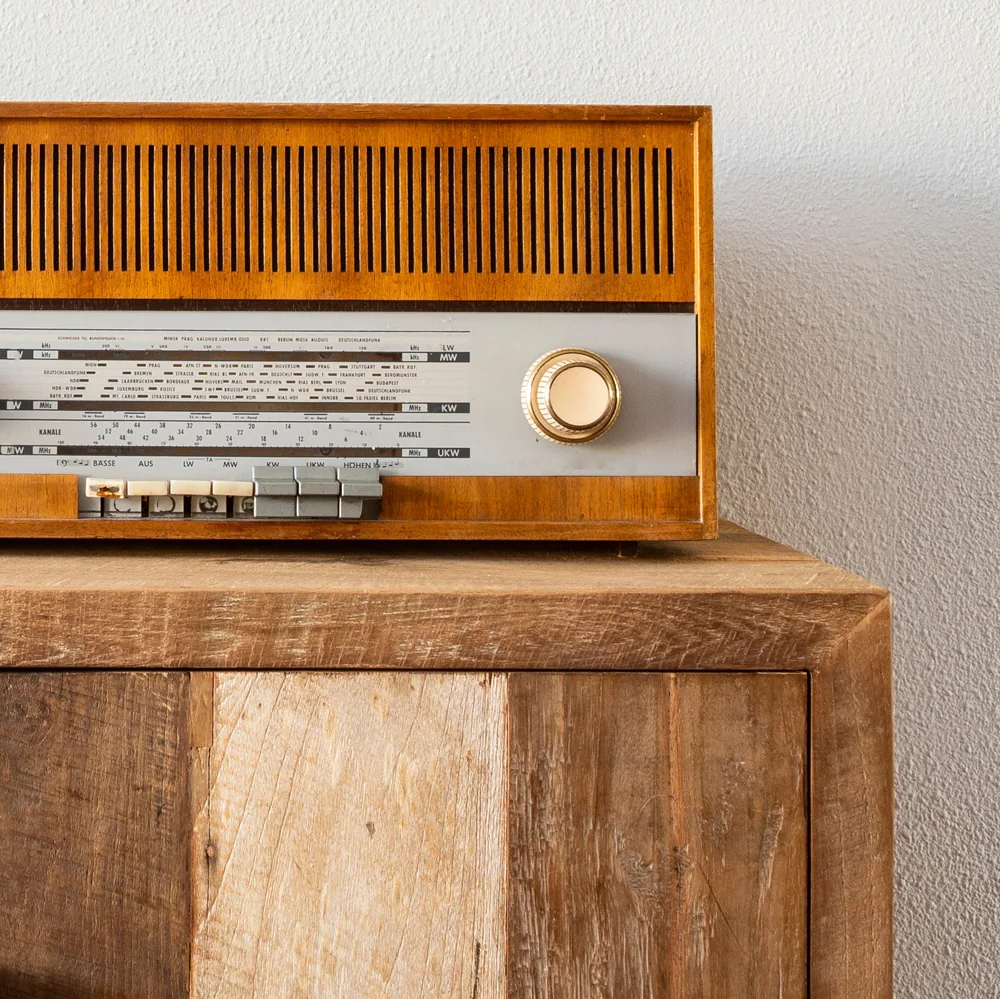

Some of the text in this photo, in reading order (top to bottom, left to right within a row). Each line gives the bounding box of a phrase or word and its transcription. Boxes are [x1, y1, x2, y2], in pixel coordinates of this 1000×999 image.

[409, 353, 458, 362] kHz MW
[441, 404, 458, 413] KW
[437, 448, 460, 457] UKW
